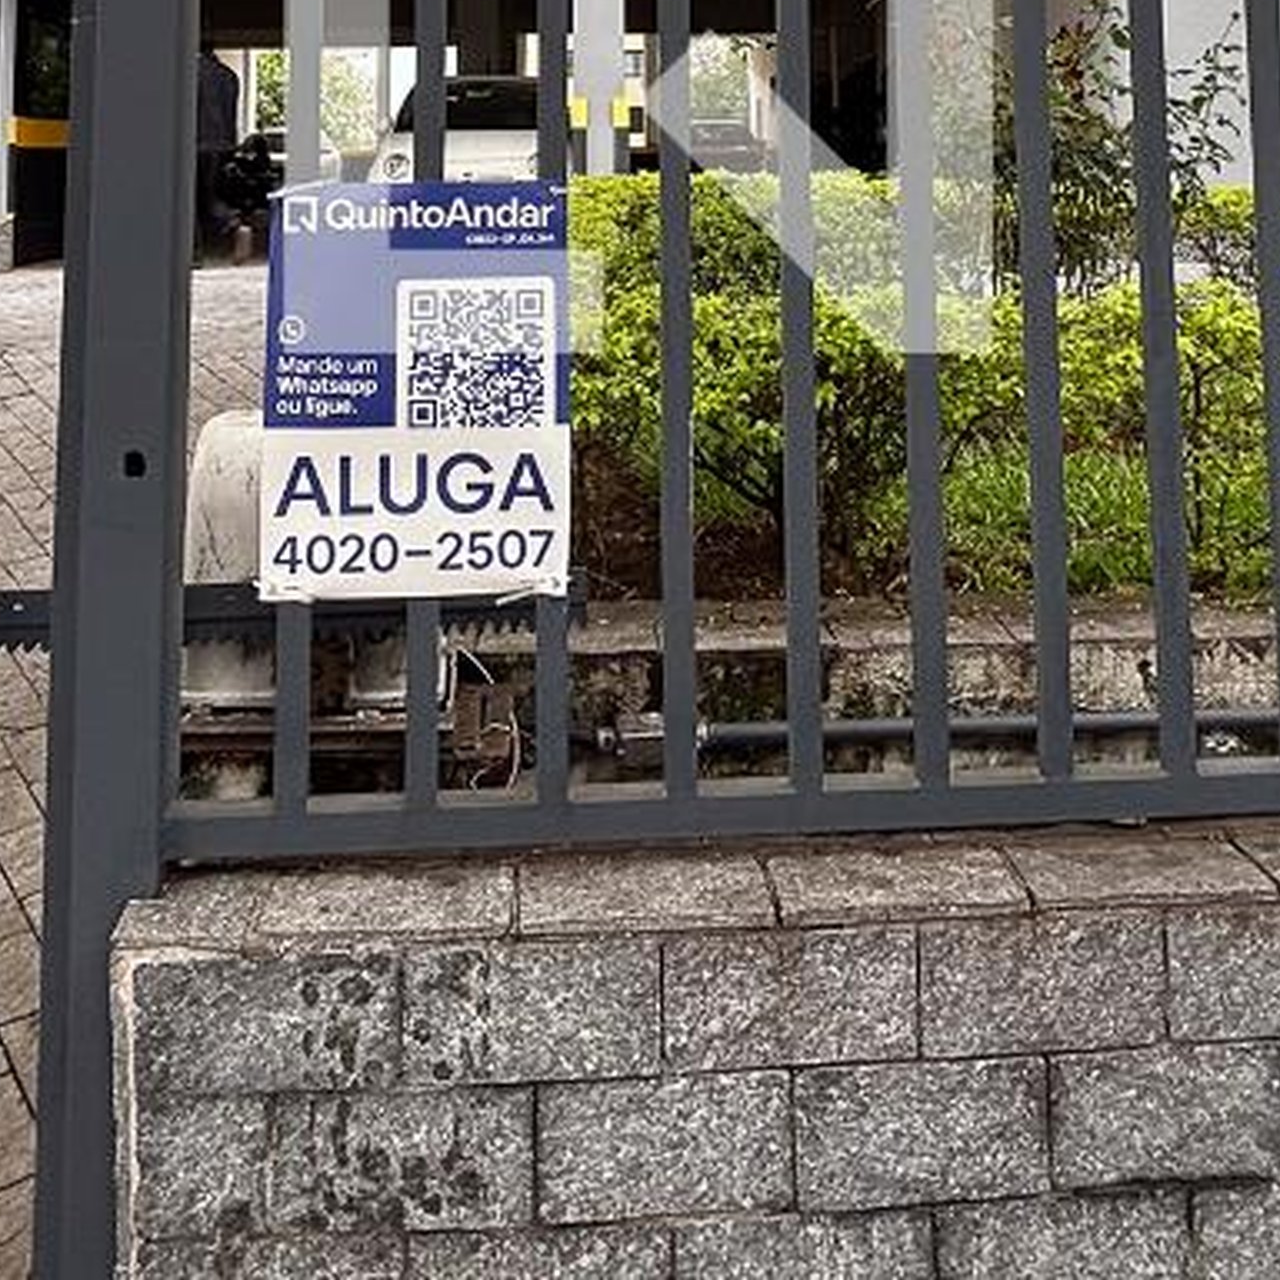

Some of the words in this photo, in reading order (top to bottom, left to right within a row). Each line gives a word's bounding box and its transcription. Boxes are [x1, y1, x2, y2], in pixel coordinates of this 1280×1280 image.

[325, 196, 555, 232] QuintoAndar
[277, 355, 344, 375] Mande
[346, 358, 378, 375] um
[276, 376, 378, 398] Whatsapp
[275, 399, 301, 415] ou
[273, 451, 555, 518] ALUGA
[272, 529, 555, 575] 4020-2507
